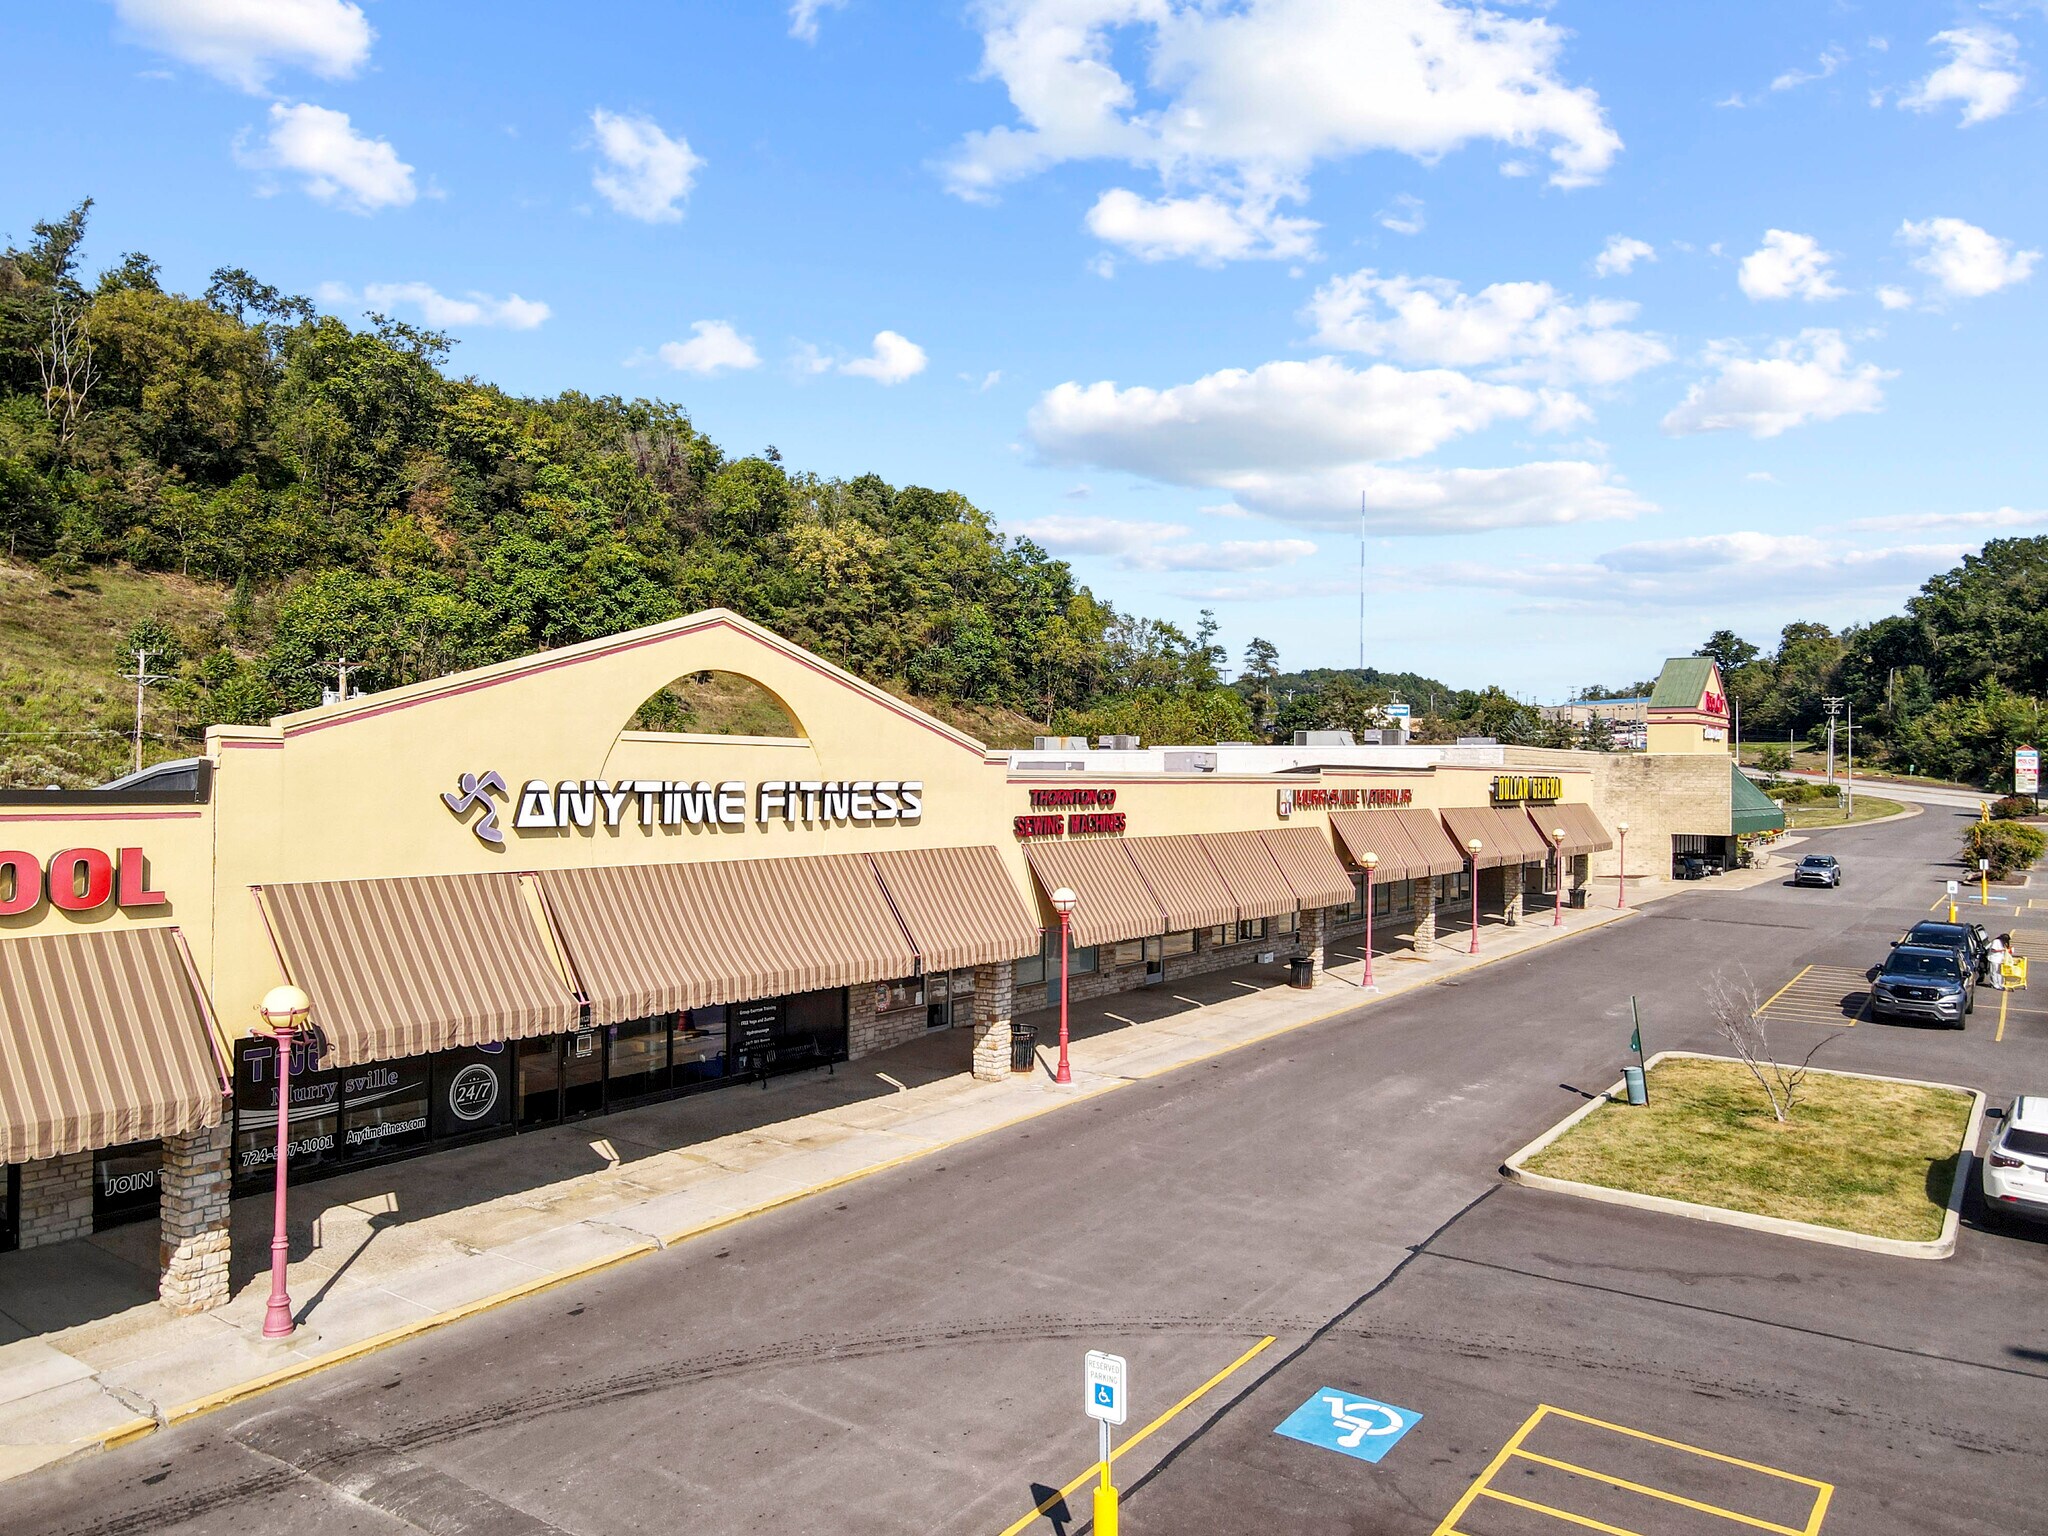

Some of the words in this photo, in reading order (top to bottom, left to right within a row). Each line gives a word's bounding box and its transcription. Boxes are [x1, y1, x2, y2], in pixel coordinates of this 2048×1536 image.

[1029, 789, 1097, 806] THORNTON
[1499, 777, 1529, 800] DOLLAR
[1532, 777, 1563, 800] GENERAL
[516, 779, 746, 829] ANYTIME
[760, 780, 924, 824] FITNESS
[1013, 815, 1064, 836] SEWING
[1068, 812, 1126, 834] MACHINES
[456, 1081, 492, 1103] 24/7
[346, 1117, 427, 1146] Anytimefitness.com
[241, 1135, 335, 1167] 724-37-1001
[104, 1170, 154, 1197] JOIN
[1089, 1360, 1119, 1373] RESERVED
[1090, 1371, 1118, 1384] PARKING
